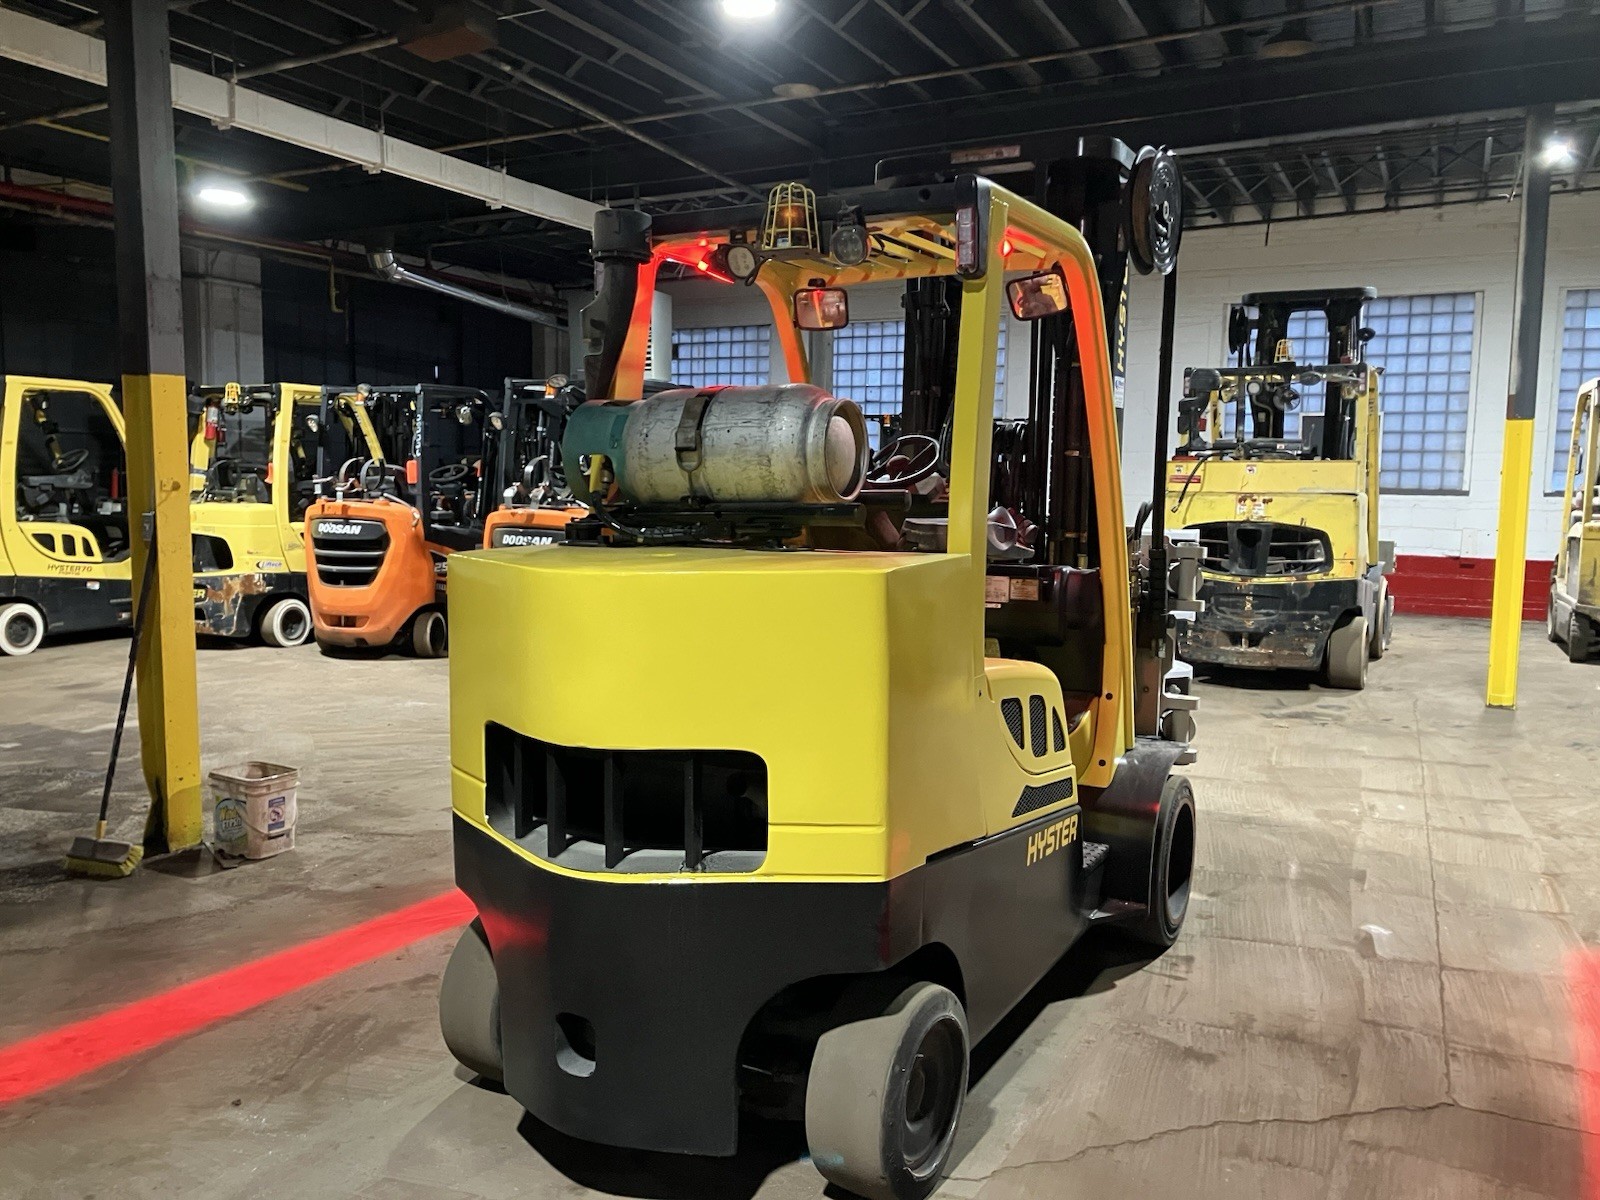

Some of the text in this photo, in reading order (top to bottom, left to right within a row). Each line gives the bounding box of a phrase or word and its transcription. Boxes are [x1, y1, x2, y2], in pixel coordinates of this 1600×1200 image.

[1117, 258, 1129, 373] HYST
[318, 522, 362, 535] DOOSAN
[502, 534, 553, 545] DOOSAN
[47, 564, 81, 572] HYSTER
[1027, 814, 1078, 867] HYSTER
